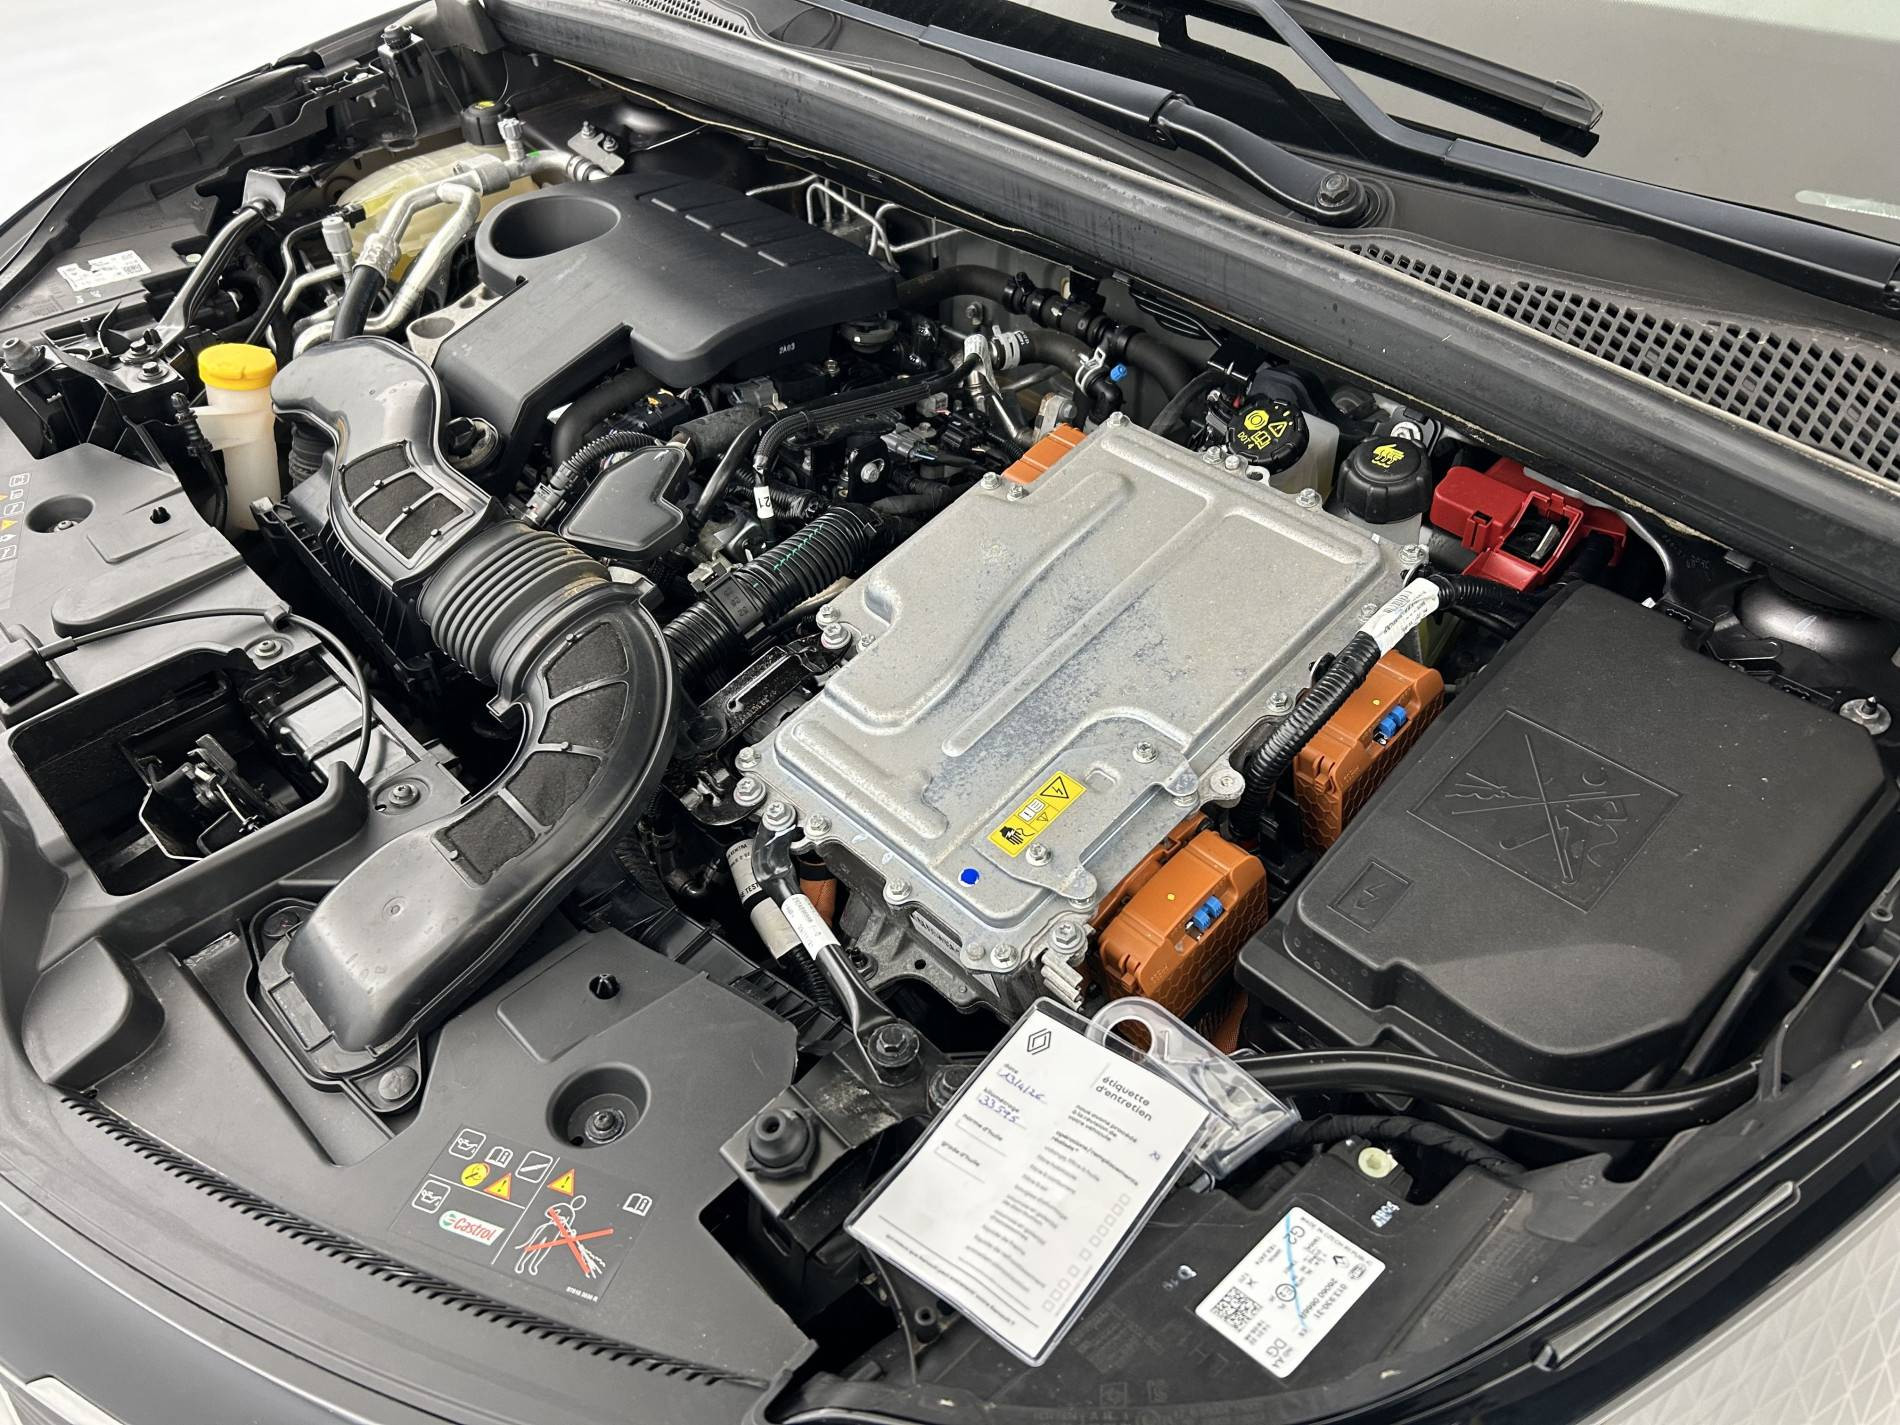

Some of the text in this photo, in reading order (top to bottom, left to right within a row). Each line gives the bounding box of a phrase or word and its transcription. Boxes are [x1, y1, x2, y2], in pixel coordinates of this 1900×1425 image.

[1237, 431, 1251, 444] DOT
[1102, 1076, 1150, 1106] étiquette
[1095, 1085, 1152, 1122] d'entretien
[453, 1216, 493, 1240] Castrol
[1283, 1225, 1306, 1245] G2
[1265, 1337, 1288, 1358] DG
